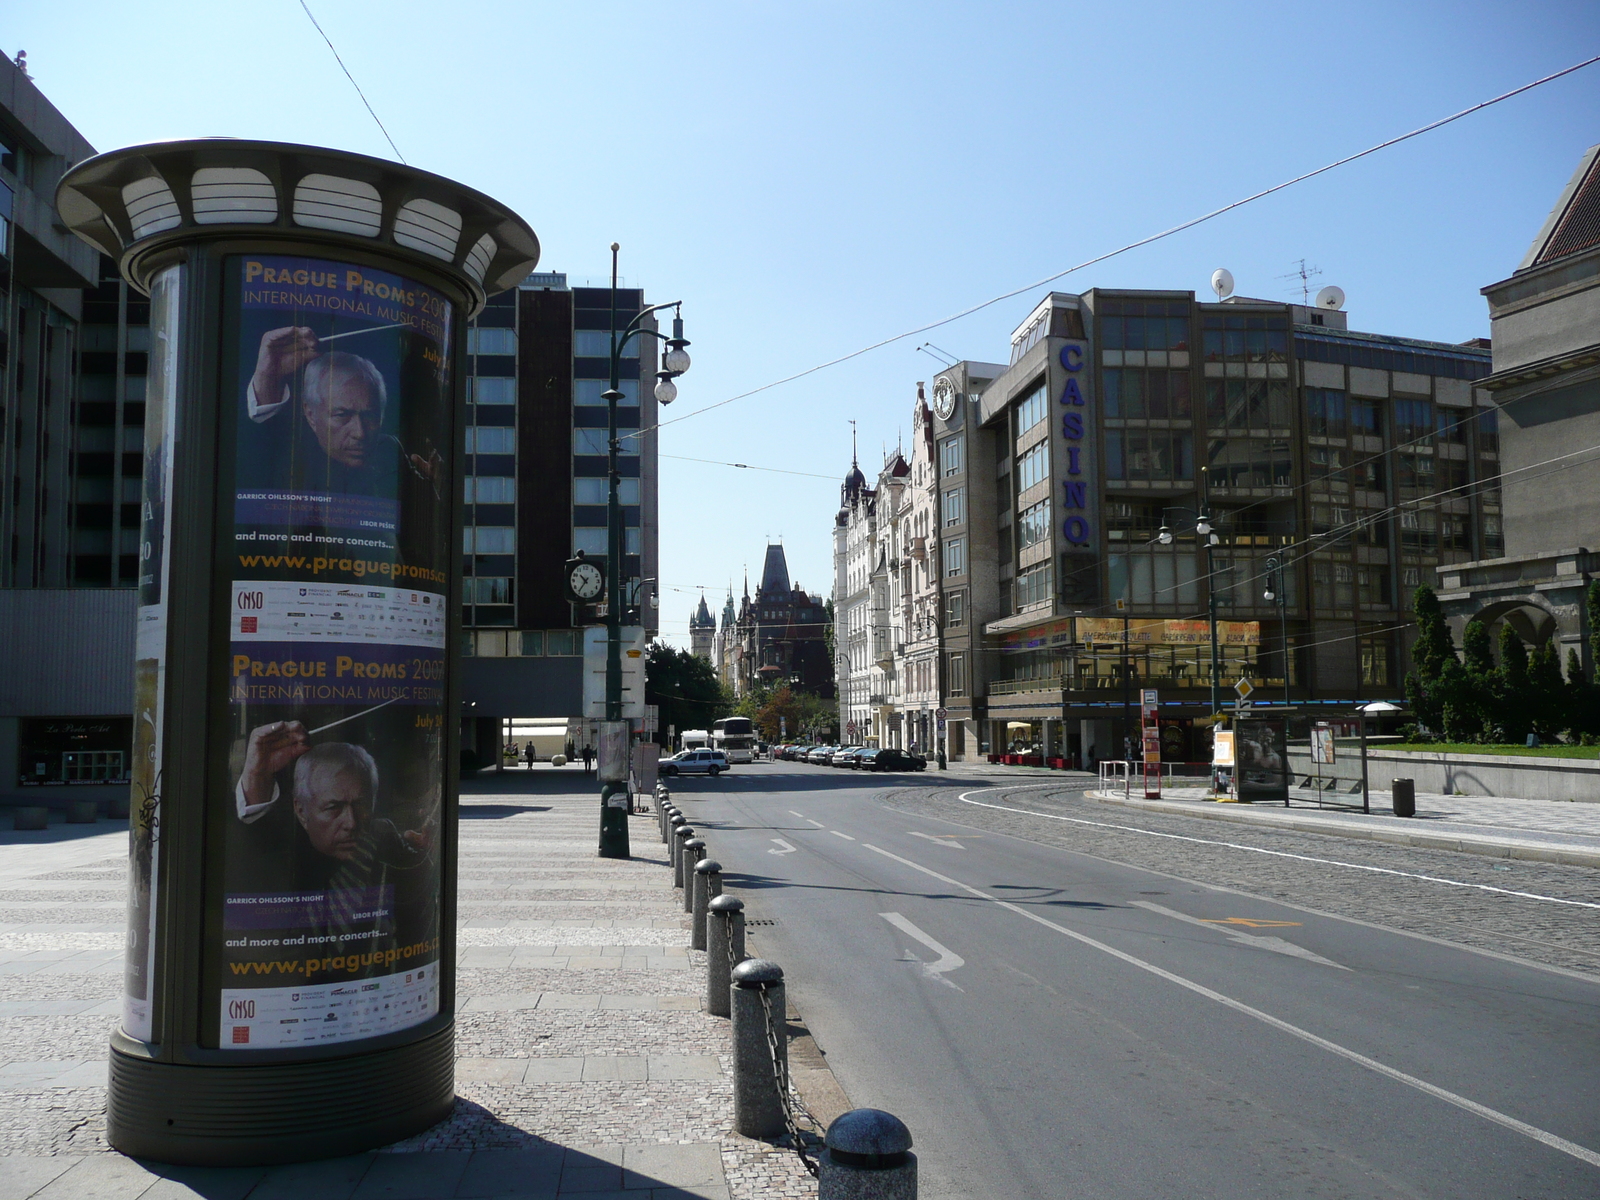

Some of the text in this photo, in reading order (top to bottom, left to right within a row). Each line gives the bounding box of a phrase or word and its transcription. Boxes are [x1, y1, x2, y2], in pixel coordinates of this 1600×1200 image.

[245, 261, 451, 324] PRAGUE PROMS 200
[244, 290, 451, 344] INTERNATIONAL MUSIC FESTIV
[422, 346, 442, 368] July
[1060, 344, 1089, 543] CASINO
[268, 493, 309, 502] OHLSSON'S
[309, 495, 332, 503] NIGHT
[359, 520, 378, 528] LIBOR
[235, 531, 395, 549] and more and more concerts...
[239, 554, 446, 583] www.pragueproms.cz
[237, 590, 264, 610] CNSO
[1120, 632, 1151, 641] RULETTE
[232, 655, 445, 681] PRAGUE PROMS 2007
[231, 685, 363, 700] INTERNATIONAL
[367, 686, 410, 700] MUSIC
[415, 713, 434, 731] July
[226, 894, 325, 905] GARRICK OHLSSON'S NIGHT
[352, 911, 372, 920] LIBOR
[225, 929, 388, 947] and more and more concerts...
[229, 936, 440, 977] www.pragueproms.cz
[228, 999, 255, 1019] CNSO
